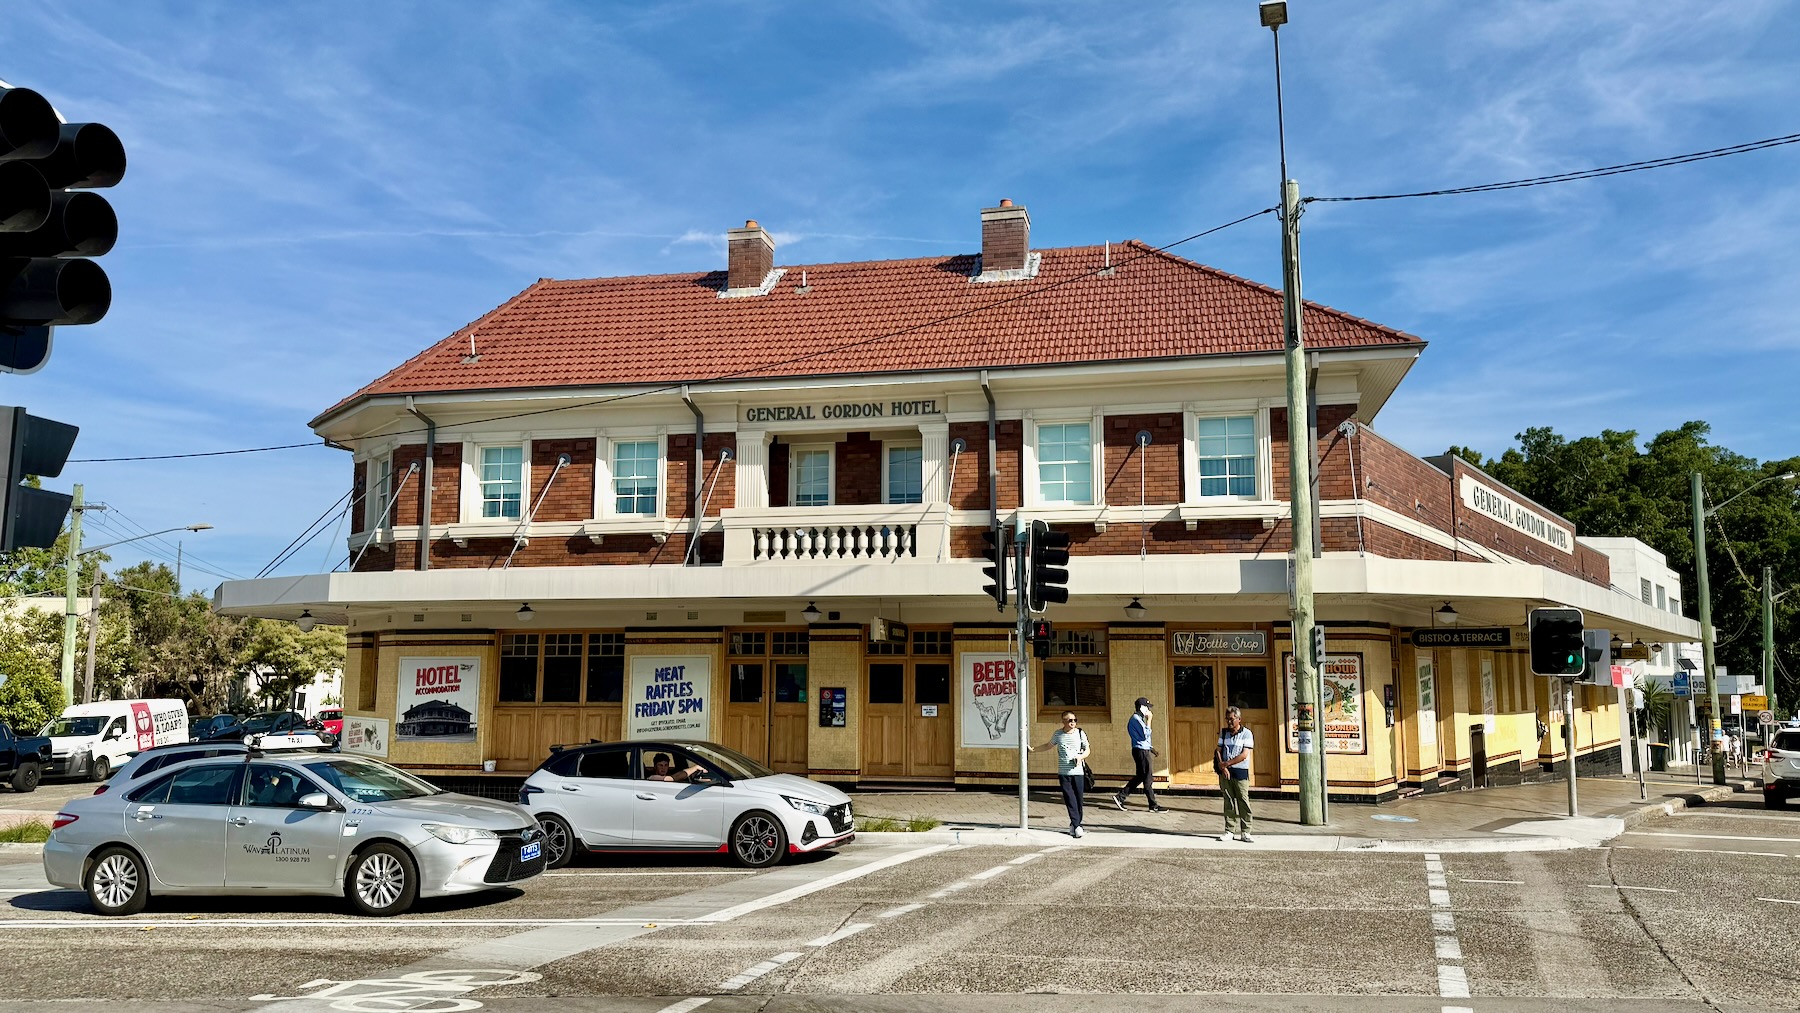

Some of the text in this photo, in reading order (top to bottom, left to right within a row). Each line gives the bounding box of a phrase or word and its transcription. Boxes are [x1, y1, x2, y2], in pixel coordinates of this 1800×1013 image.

[746, 400, 941, 422] GENERAL GORDON HOTEL
[1473, 485, 1568, 549] GENERAL GORDON HOTEL
[1195, 636, 1259, 652] Bottle Shop
[1419, 633, 1503, 643] BISTRO & TERRACE
[415, 665, 461, 687] HOTEL
[655, 665, 685, 682] MEAT
[973, 660, 1017, 683] BEER
[1325, 664, 1357, 674] HOUR
[415, 685, 460, 695] ACCOMMODATION
[646, 681, 694, 700] RAFFLES
[973, 681, 1018, 697] GARDEN
[153, 709, 184, 722] WHO GIVES
[635, 697, 703, 718] FRIDAY 5PM
[156, 724, 160, 734] A
